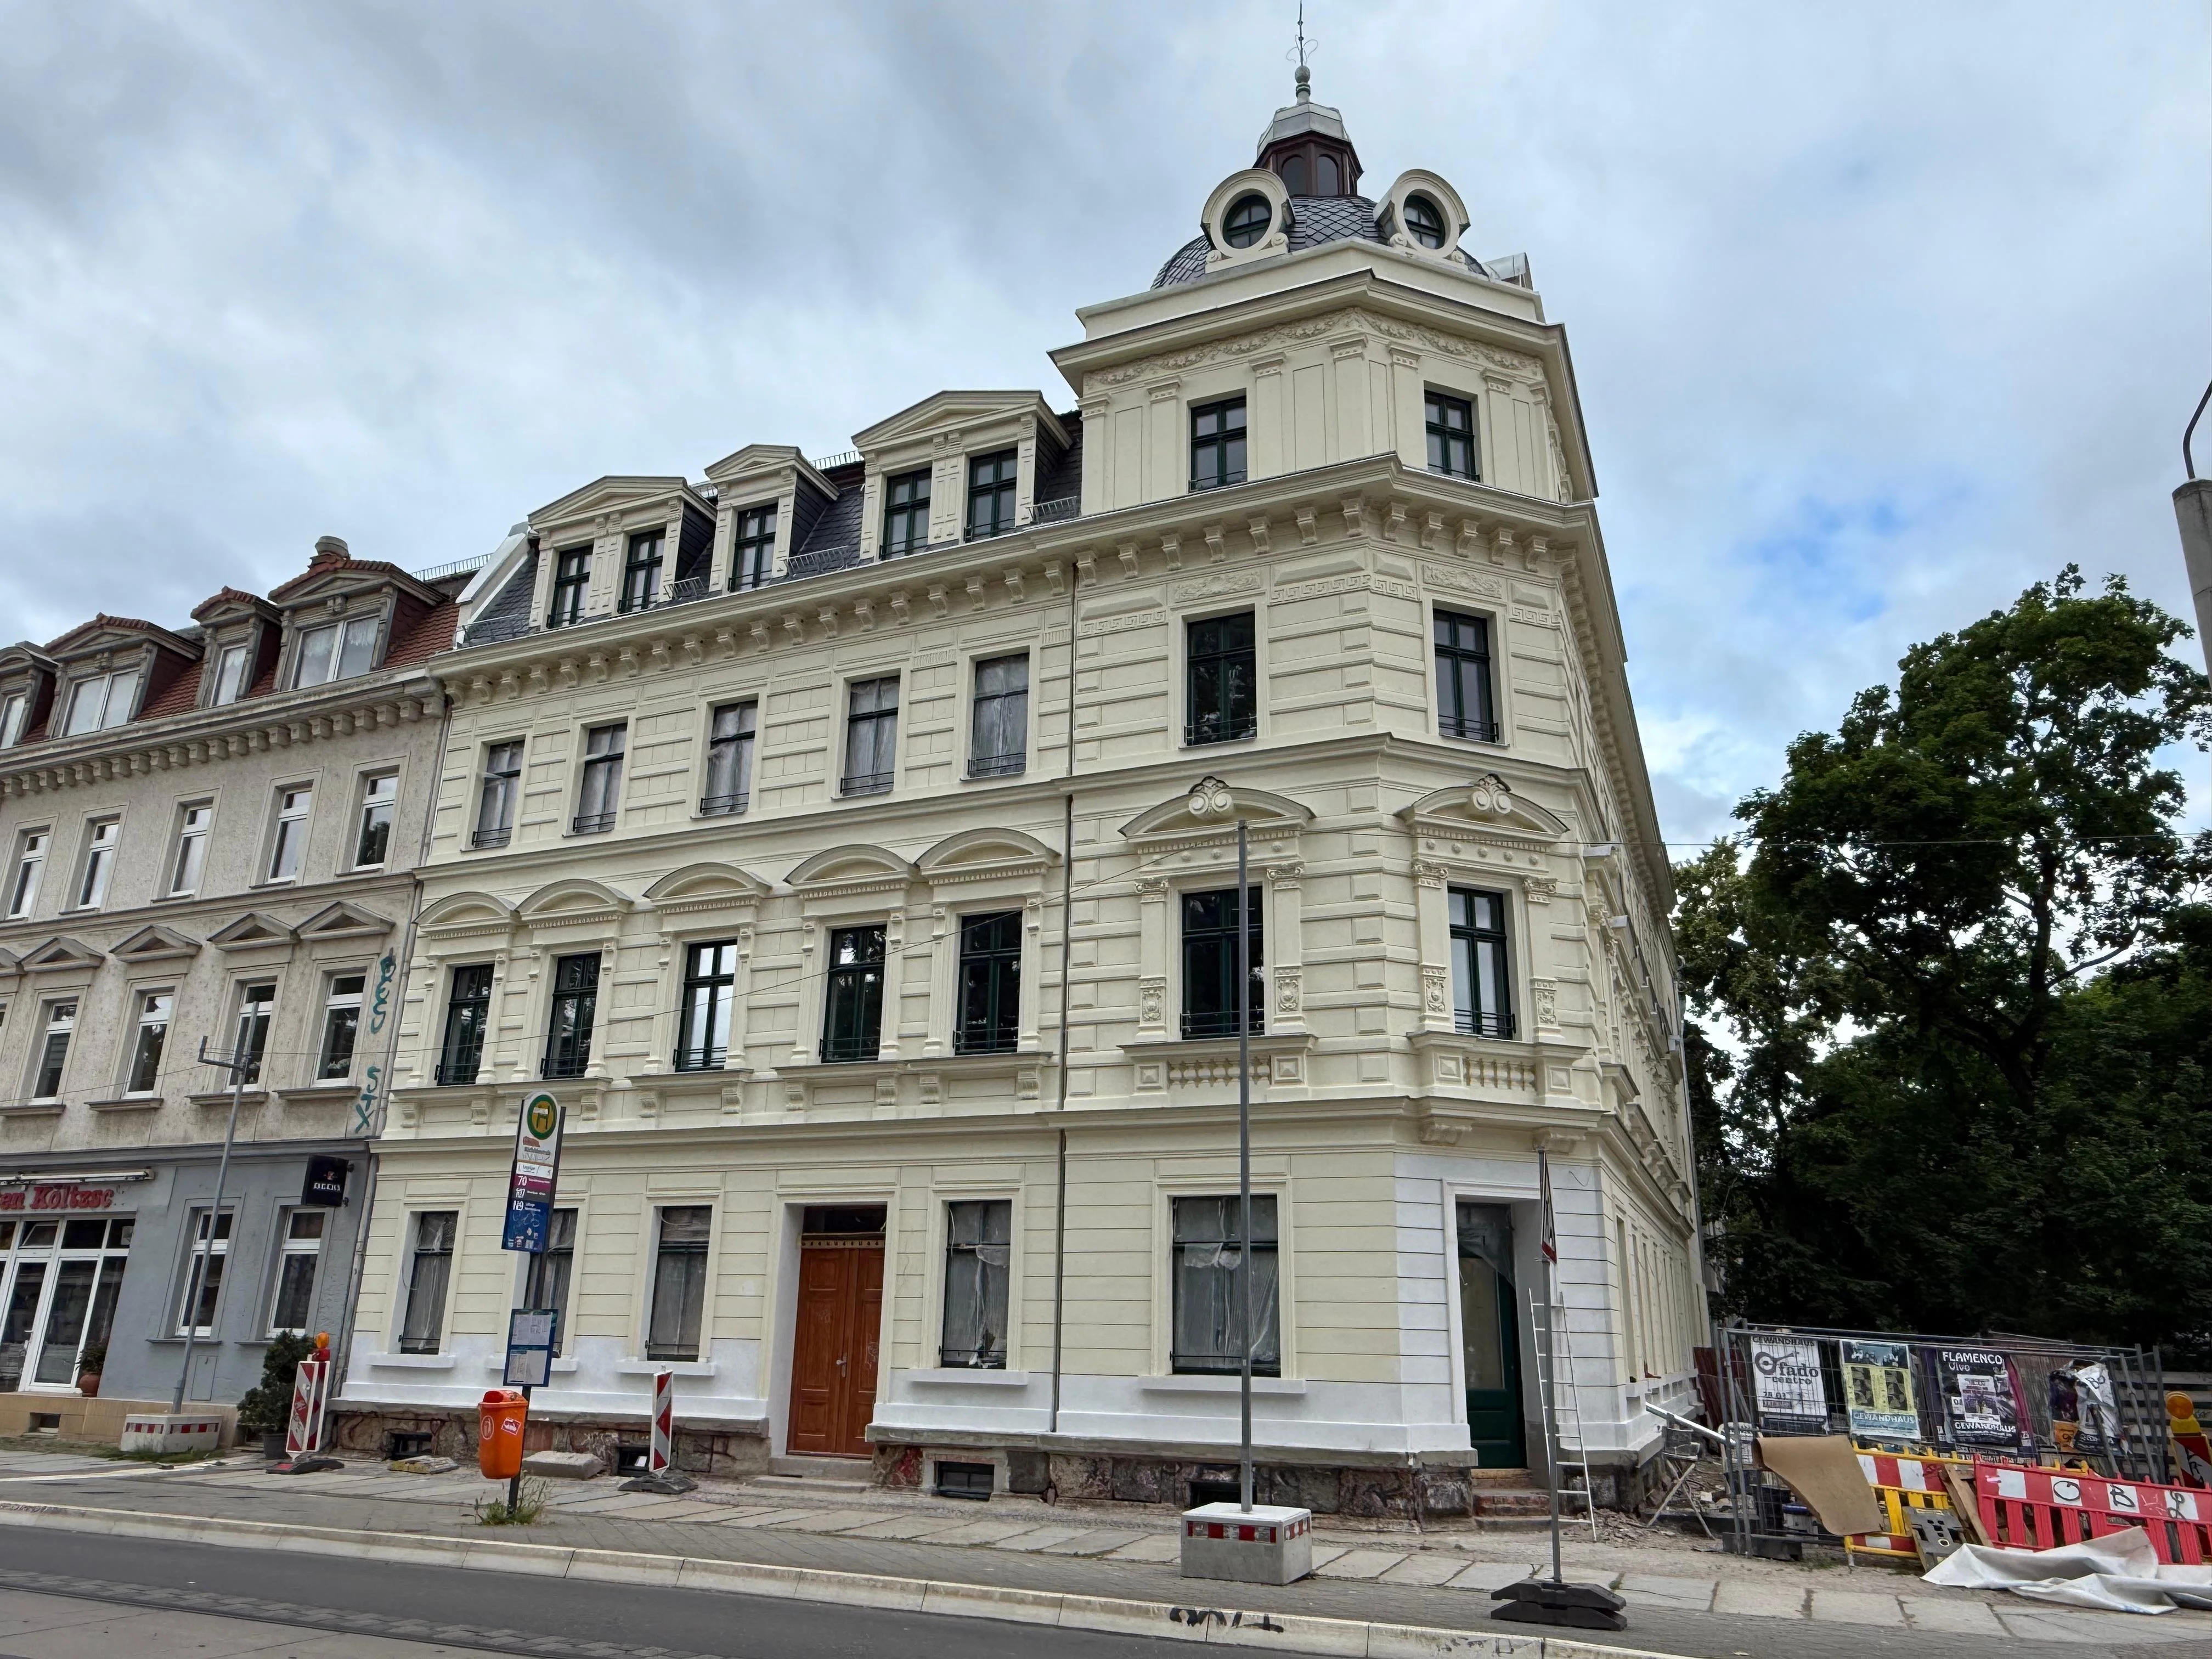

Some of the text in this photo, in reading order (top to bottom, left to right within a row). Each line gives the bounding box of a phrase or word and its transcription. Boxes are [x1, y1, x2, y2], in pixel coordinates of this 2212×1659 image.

[518, 1176, 527, 1186] 70
[1942, 1351, 2003, 1365] FLAMENCO
[1779, 1362, 1819, 1378] fado
[1773, 1376, 1812, 1385] centro
[1854, 1412, 1915, 1424] GEWANDHAUS
[1955, 1422, 2017, 1433] GEWANDHAUS
